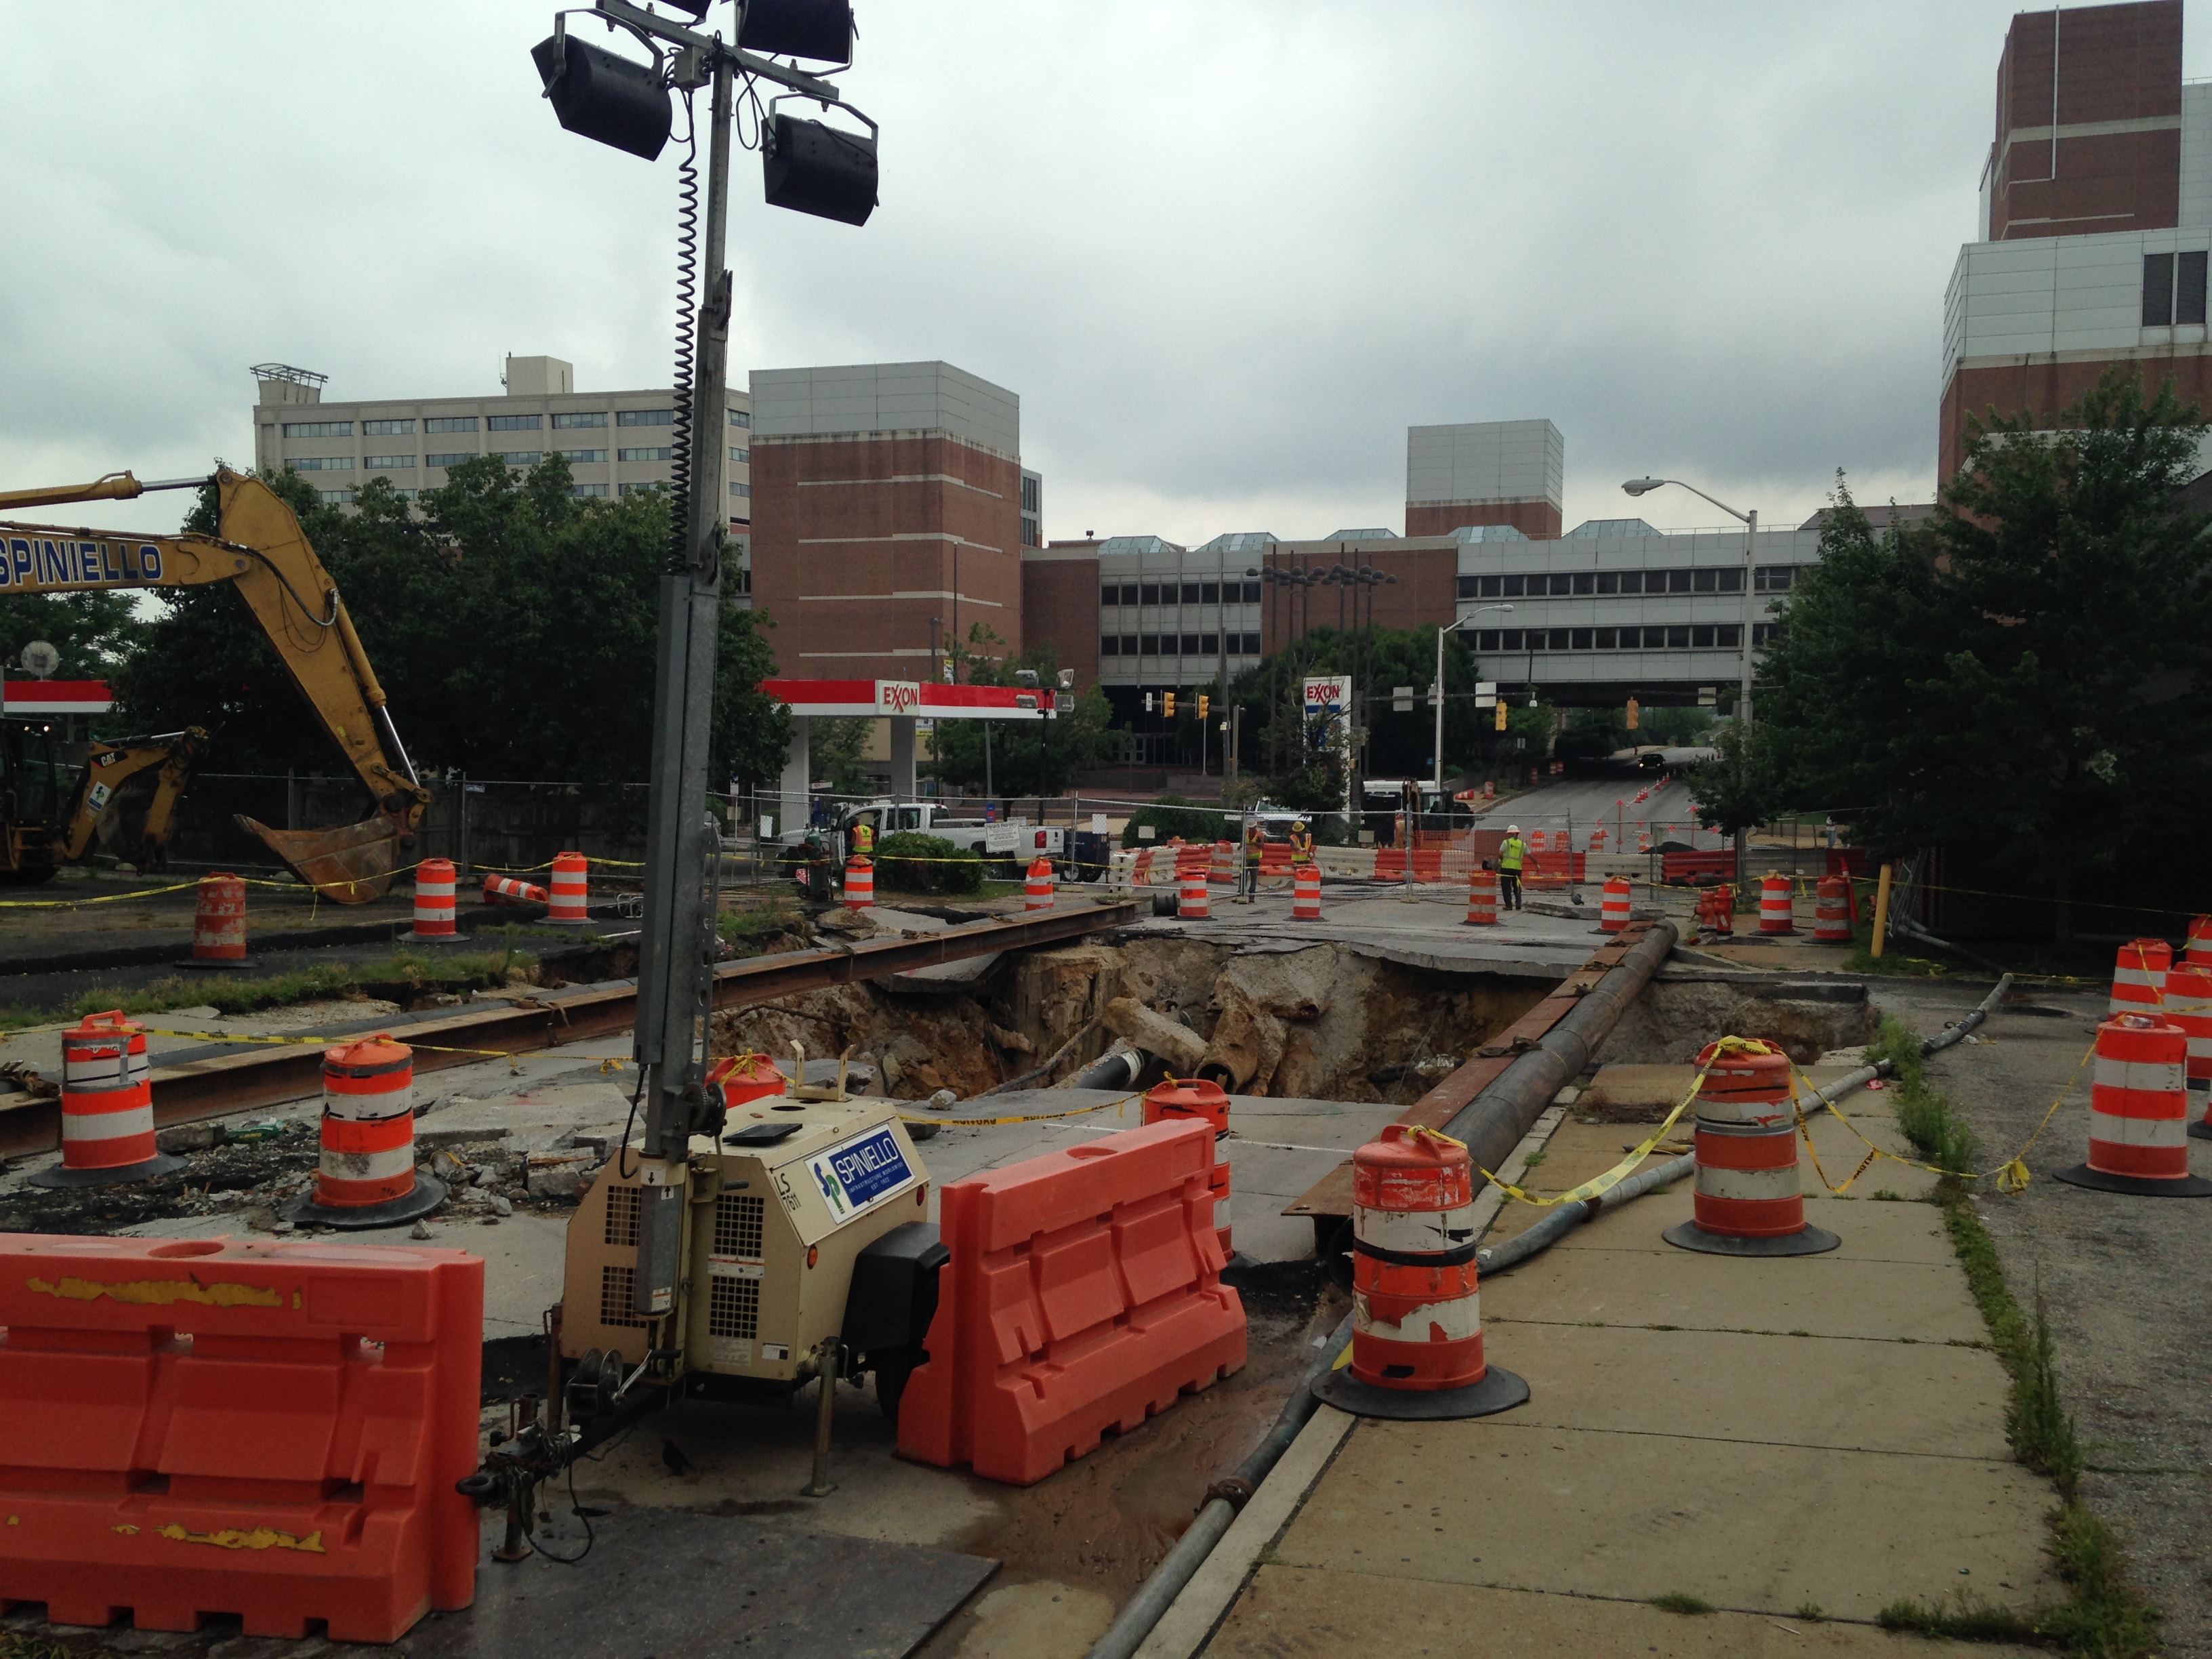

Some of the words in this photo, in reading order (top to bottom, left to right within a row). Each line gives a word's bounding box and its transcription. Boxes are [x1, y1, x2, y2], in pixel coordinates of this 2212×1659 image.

[884, 684, 918, 713] EXXON
[1307, 684, 1340, 705] EXXON
[101, 752, 116, 766] CAT
[836, 1137, 899, 1184] SPINIELLO
[774, 1172, 791, 1196] LS
[848, 1174, 882, 1193] INFRASTRUCTURE
[882, 1162, 904, 1176] WORLDWIDE
[781, 1193, 802, 1212] 7611
